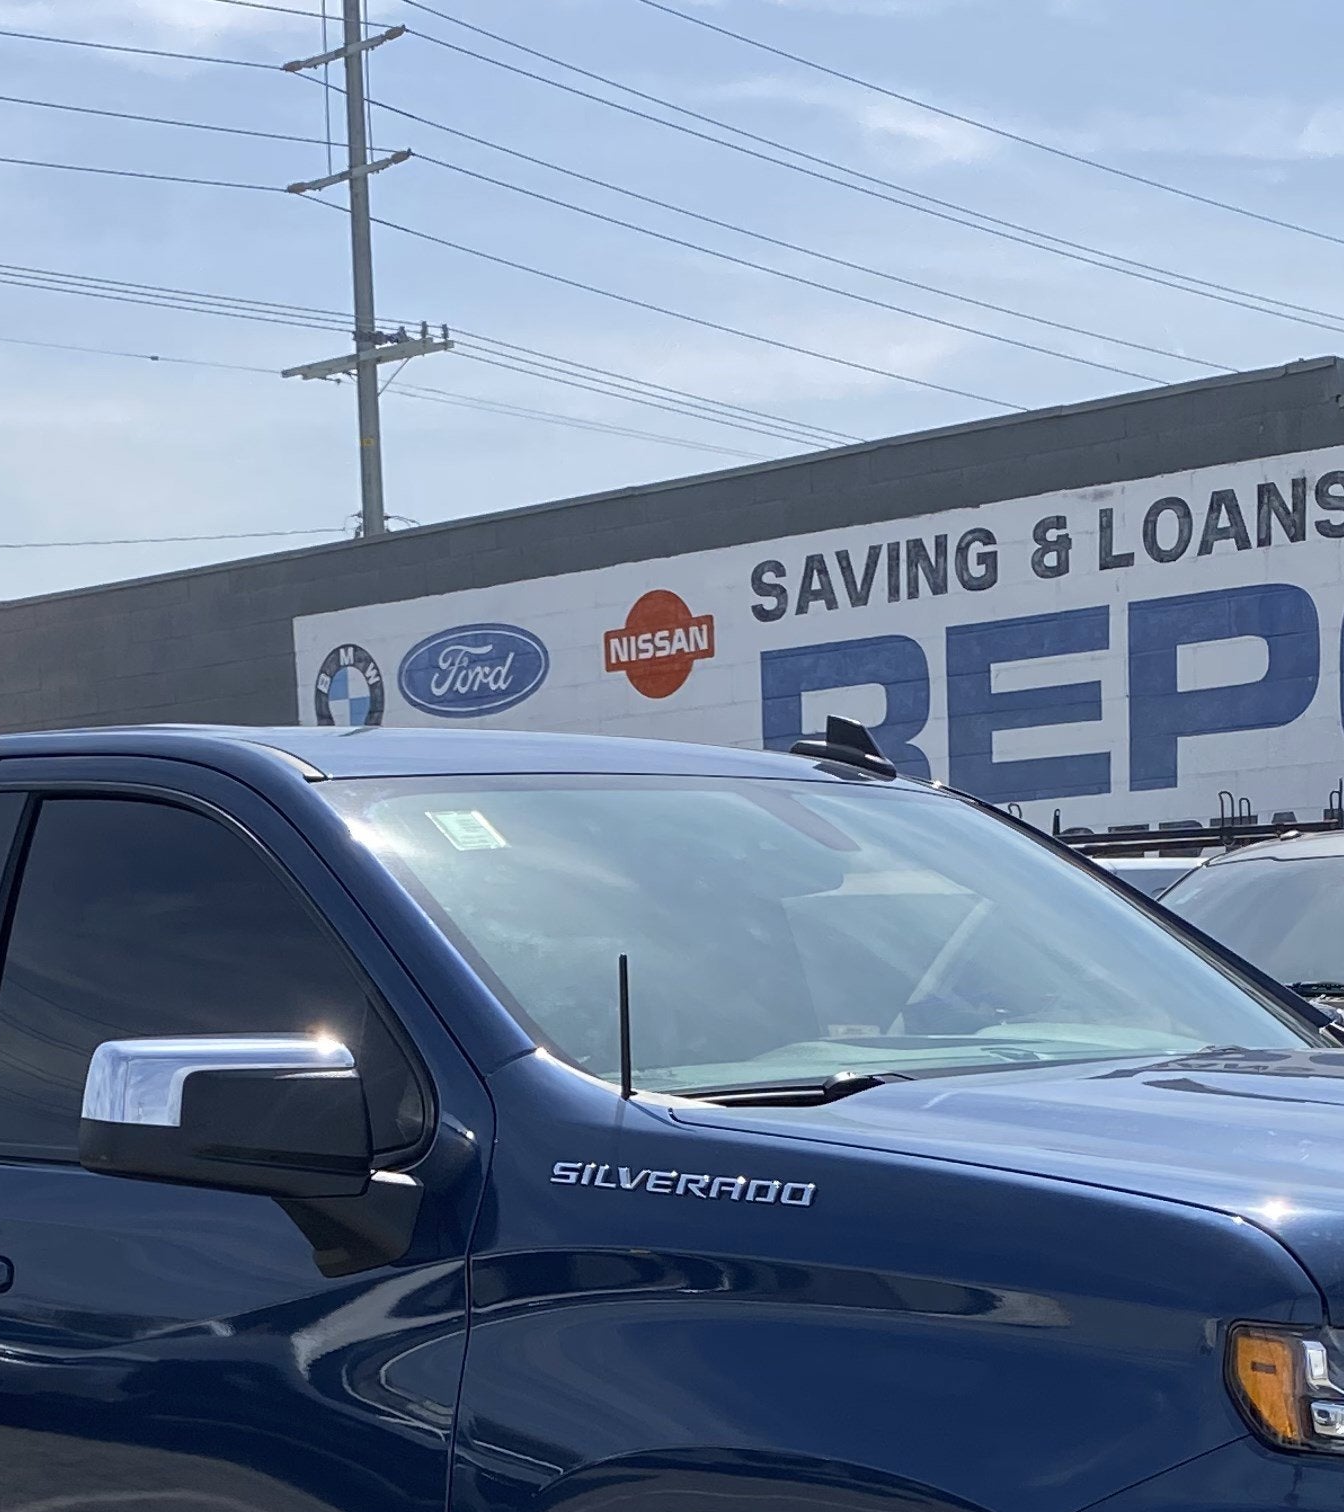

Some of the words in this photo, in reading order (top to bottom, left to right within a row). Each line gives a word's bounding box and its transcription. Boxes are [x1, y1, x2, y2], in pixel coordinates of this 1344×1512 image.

[750, 527, 998, 622] SAVING
[1031, 515, 1072, 579] &
[609, 624, 708, 664] NISSAN
[317, 646, 381, 694] BMW
[430, 644, 515, 697] Ford
[550, 1160, 817, 1207] SILVERADO
